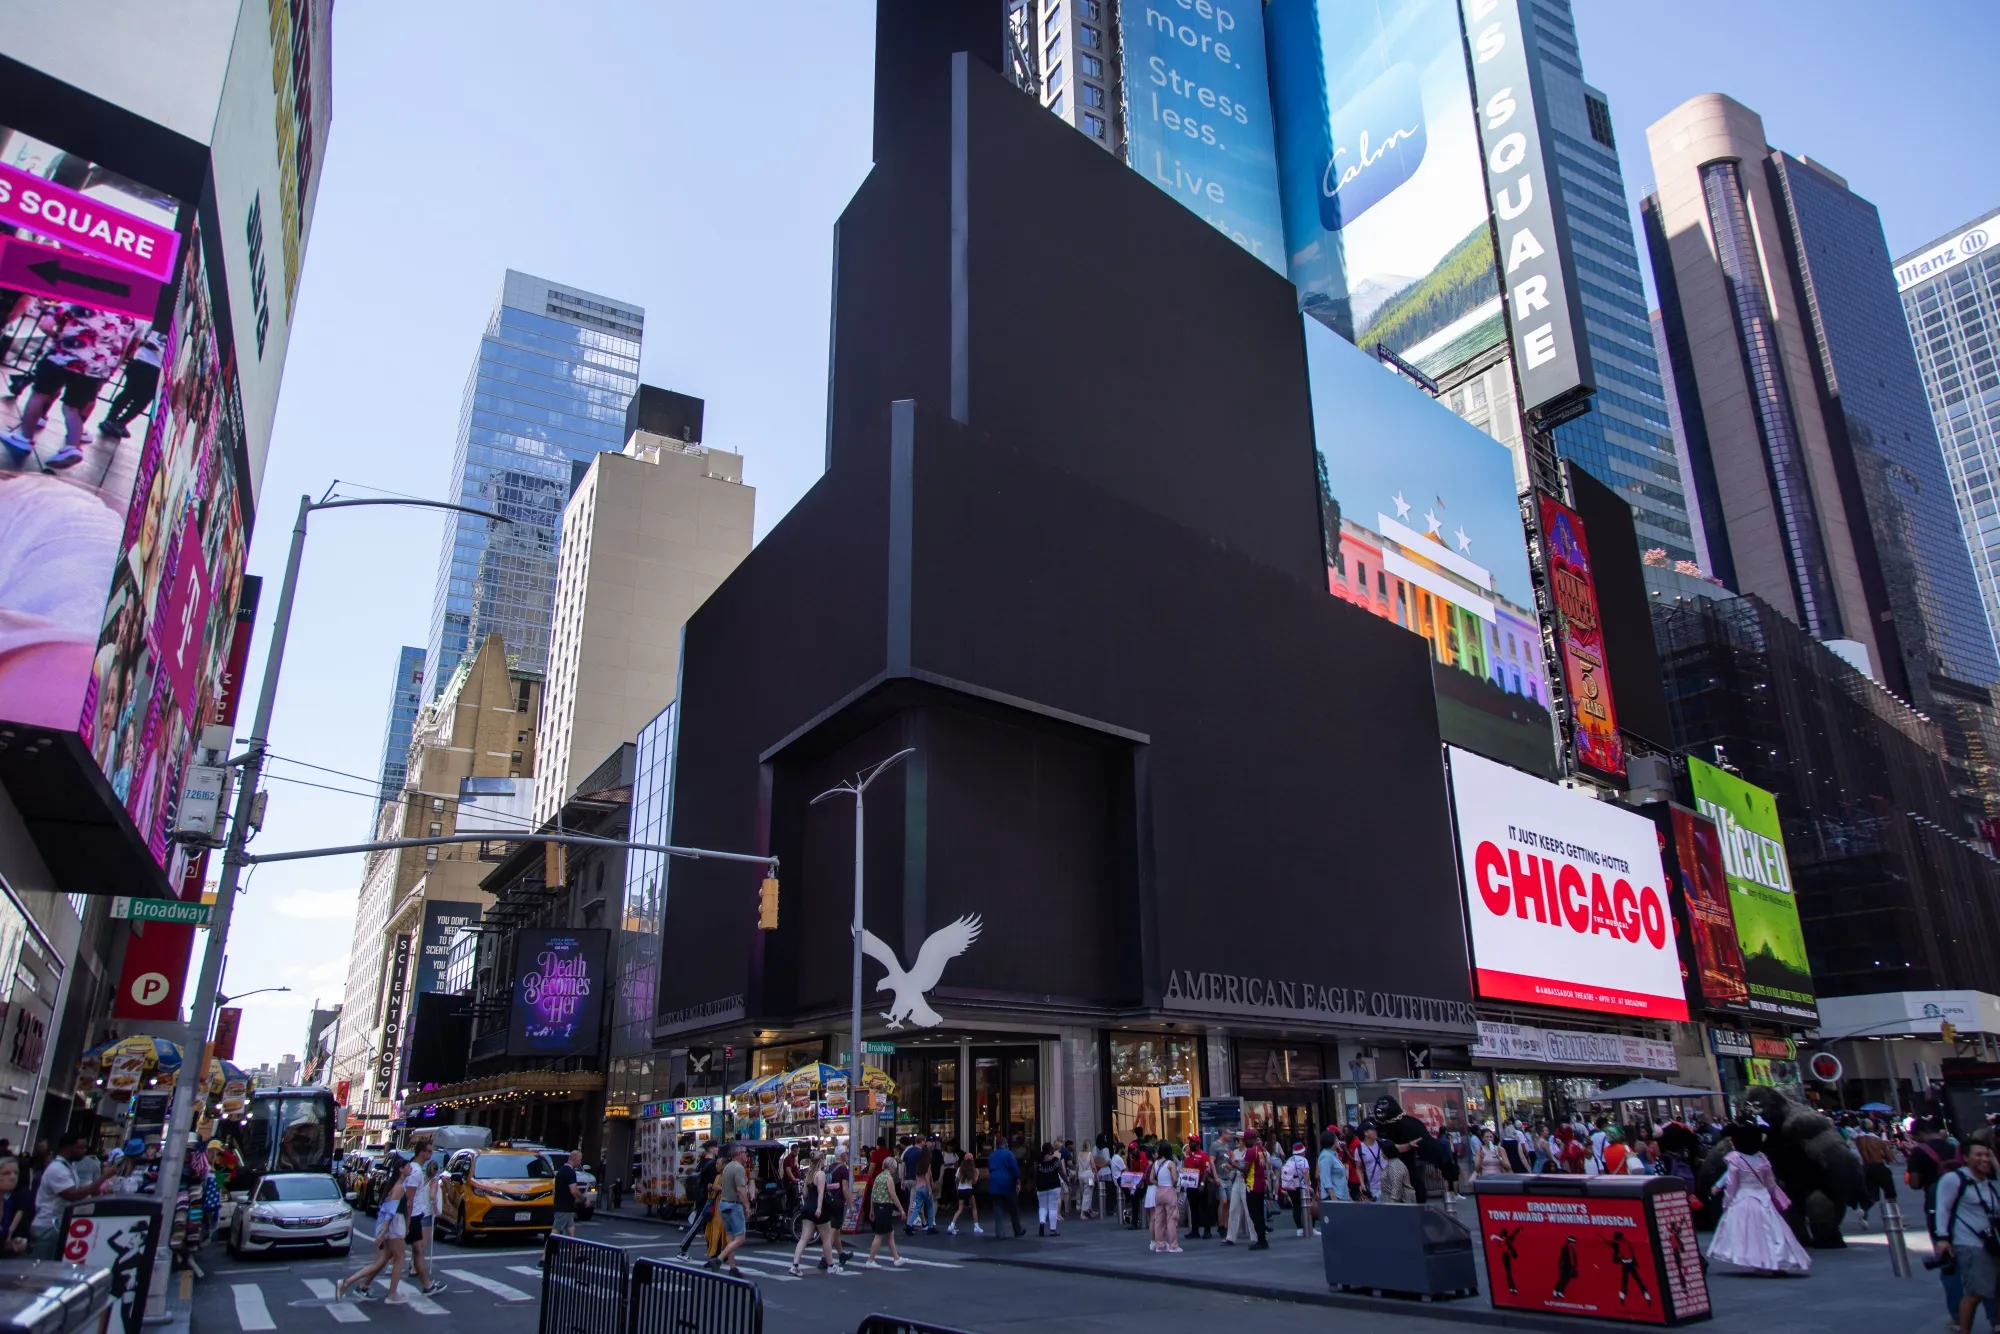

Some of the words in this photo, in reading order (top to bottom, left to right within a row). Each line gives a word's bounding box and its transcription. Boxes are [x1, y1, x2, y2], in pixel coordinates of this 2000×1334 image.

[1146, 7, 1241, 70] more.
[1149, 55, 1249, 125] Stress
[1152, 92, 1226, 150] less.
[1155, 151, 1225, 204] Live
[1322, 123, 1419, 198] Calm
[18, 190, 155, 260] SQUARE
[1485, 86, 1557, 371] SQUARE
[1897, 248, 1957, 287] llianz
[185, 789, 216, 801] 726162
[1508, 824, 1517, 841] IT
[1518, 828, 1538, 848] JUST
[1539, 834, 1566, 855] KEEPS
[1566, 843, 1601, 866] GETTING
[134, 901, 207, 922] Broadway
[1474, 840, 1667, 950] CHICAGO
[437, 915, 450, 925] YOU
[450, 916, 469, 926] DON'T
[433, 960, 447, 970] YOU
[537, 951, 587, 978] Death
[522, 971, 591, 1005] Becomes
[1164, 969, 1297, 1010] AMERICAN
[1299, 983, 1368, 1016] EAGLE
[1370, 991, 1477, 1026] OUTFITTERS
[542, 995, 579, 1023] Her
[868, 1043, 894, 1054] Broadway
[1715, 1029, 1737, 1046] BLUE
[1120, 1088, 1145, 1096] EVERY
[1488, 1209, 1511, 1221] TONY
[1591, 1215, 1637, 1228] MUSICAL
[1527, 1201, 1588, 1214] BROADWAY'S
